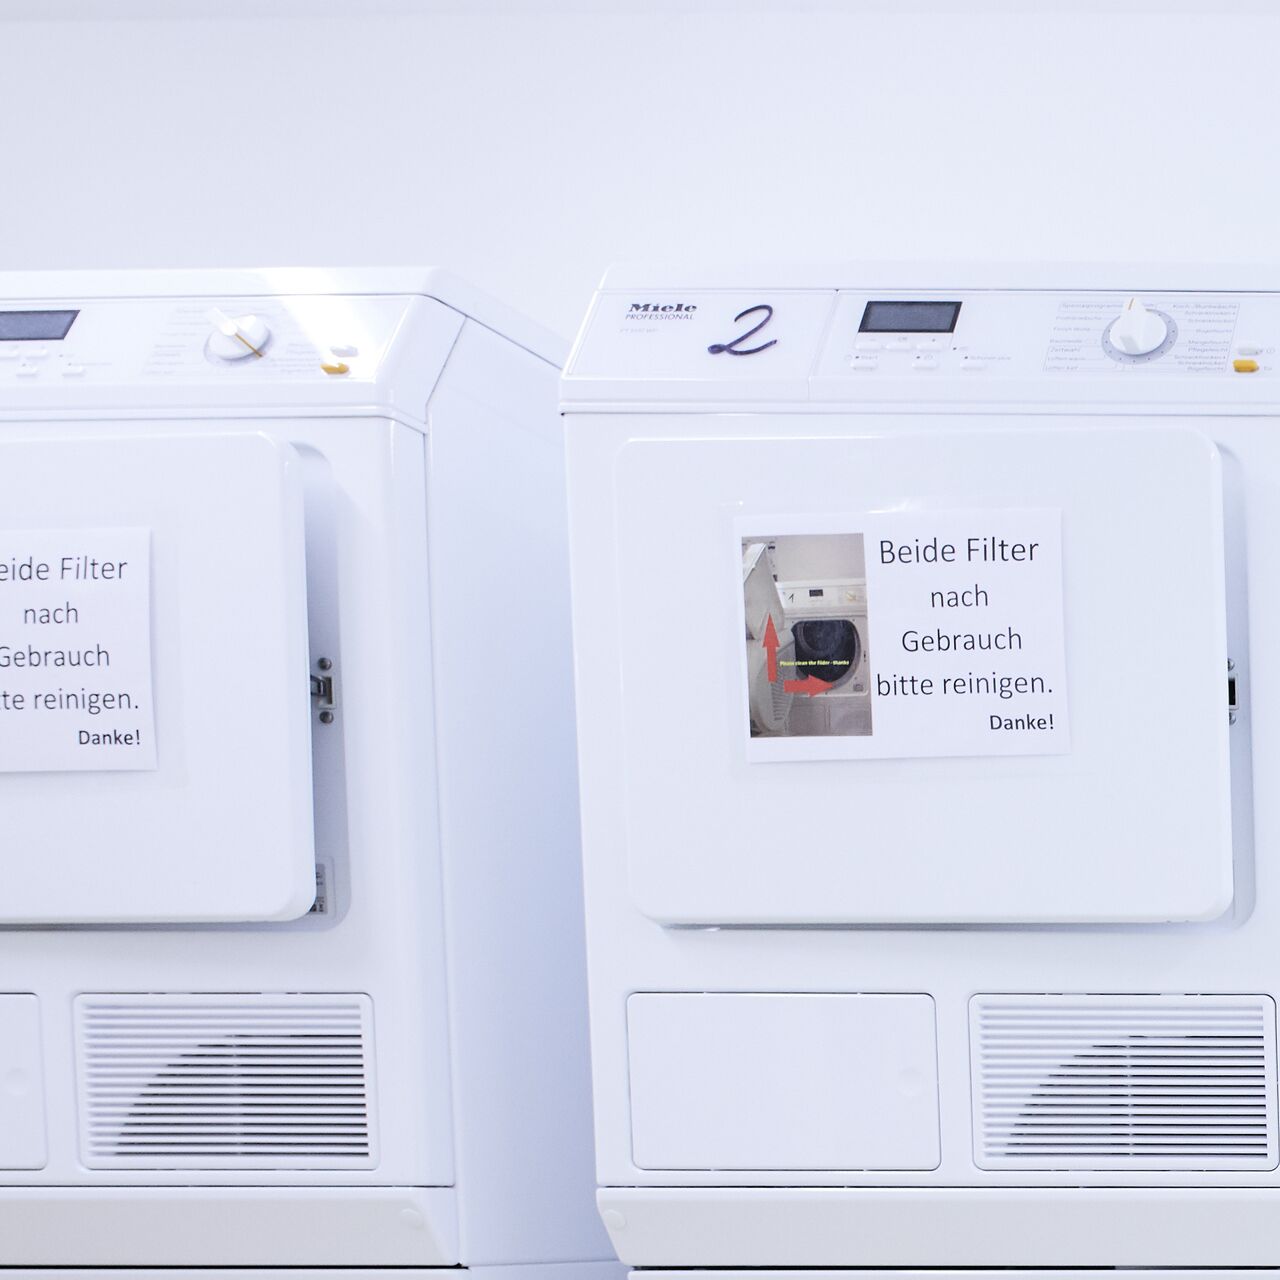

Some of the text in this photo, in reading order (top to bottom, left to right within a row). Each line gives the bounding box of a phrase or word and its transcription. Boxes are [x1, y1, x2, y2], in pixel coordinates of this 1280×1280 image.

[625, 312, 695, 320] PROFESSIONAL
[630, 304, 696, 312] Miele
[707, 304, 778, 357] 2
[880, 536, 1039, 564] Beide Filter
[60, 555, 128, 580] Filter
[931, 583, 989, 608] nach
[24, 601, 79, 625] nach
[901, 626, 1022, 653] Gebrauch
[0, 643, 110, 668] Gebrauch
[877, 671, 1053, 700] bitte reinigen.
[0, 687, 139, 716] te reinigen.
[989, 713, 1054, 731] Danke!
[78, 729, 140, 746] Danke!
